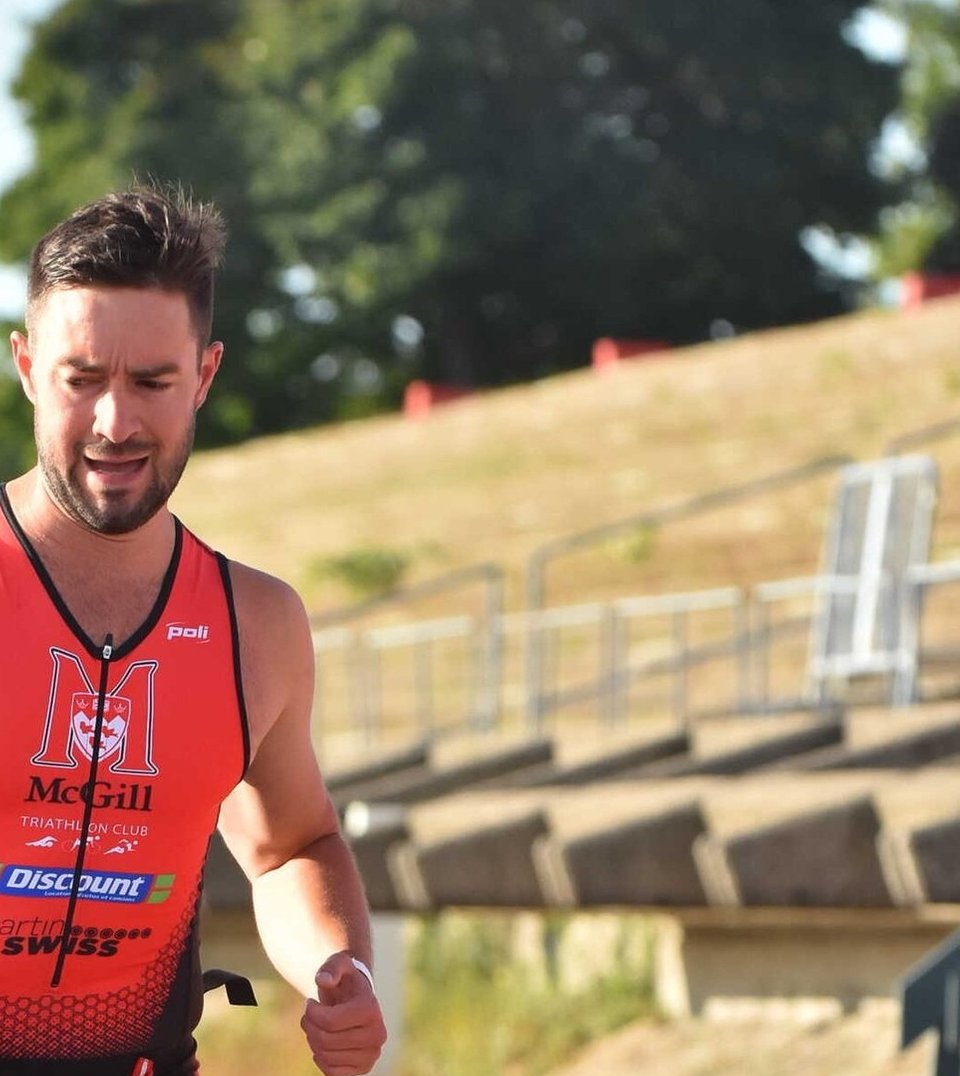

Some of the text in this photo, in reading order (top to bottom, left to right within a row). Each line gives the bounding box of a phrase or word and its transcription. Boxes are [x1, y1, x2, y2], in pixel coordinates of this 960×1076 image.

[167, 625, 209, 640] poli
[23, 776, 153, 812] McGill
[21, 815, 148, 836] TRIATHLON CLUB
[6, 868, 145, 897] Discount
